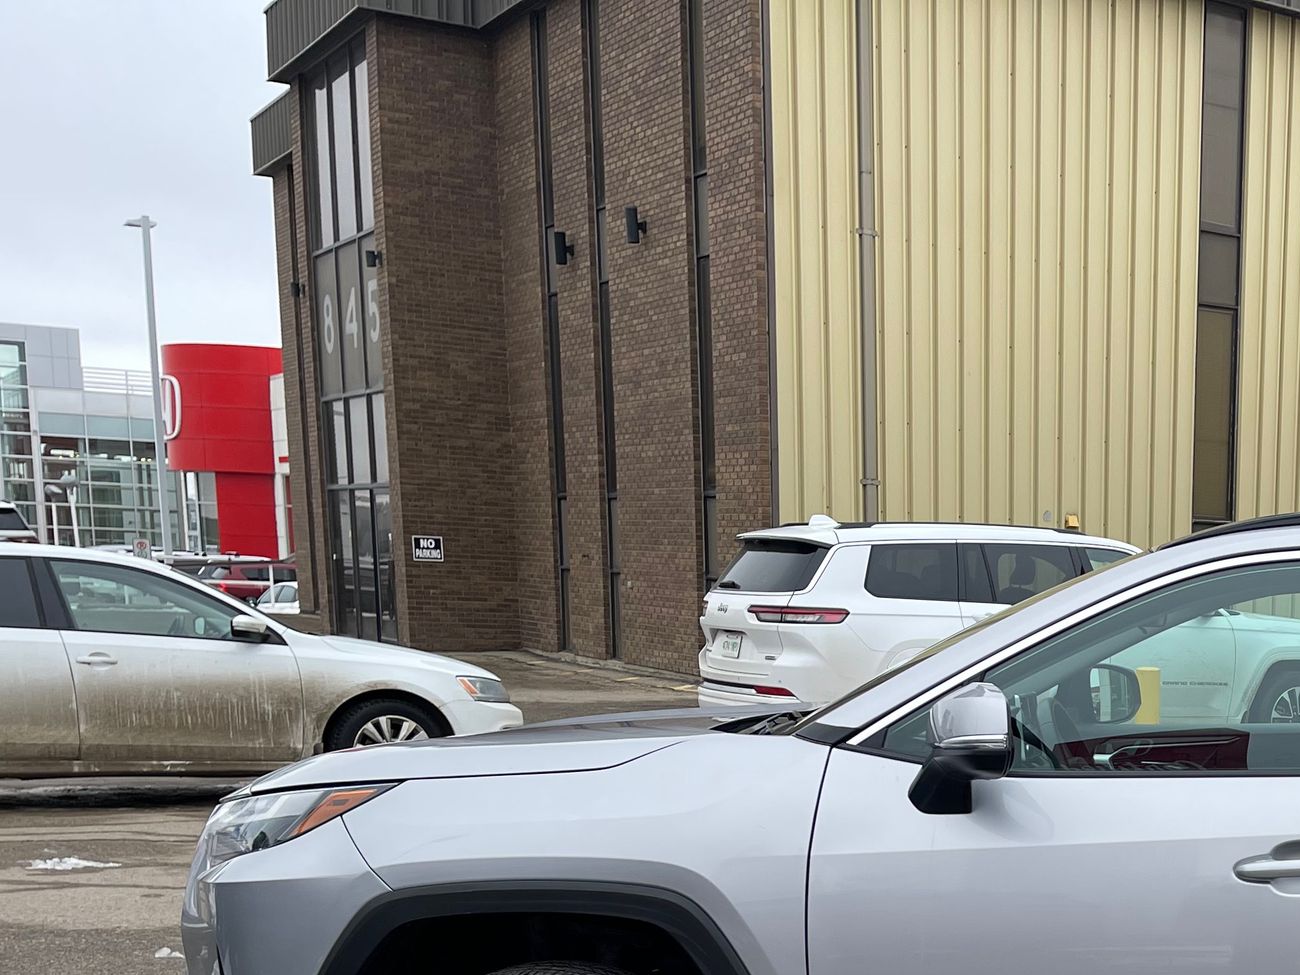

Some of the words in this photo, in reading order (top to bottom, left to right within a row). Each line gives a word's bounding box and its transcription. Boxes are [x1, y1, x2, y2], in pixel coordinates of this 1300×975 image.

[323, 278, 380, 354] 845
[420, 538, 436, 549] NO
[415, 548, 441, 559] PARKING
